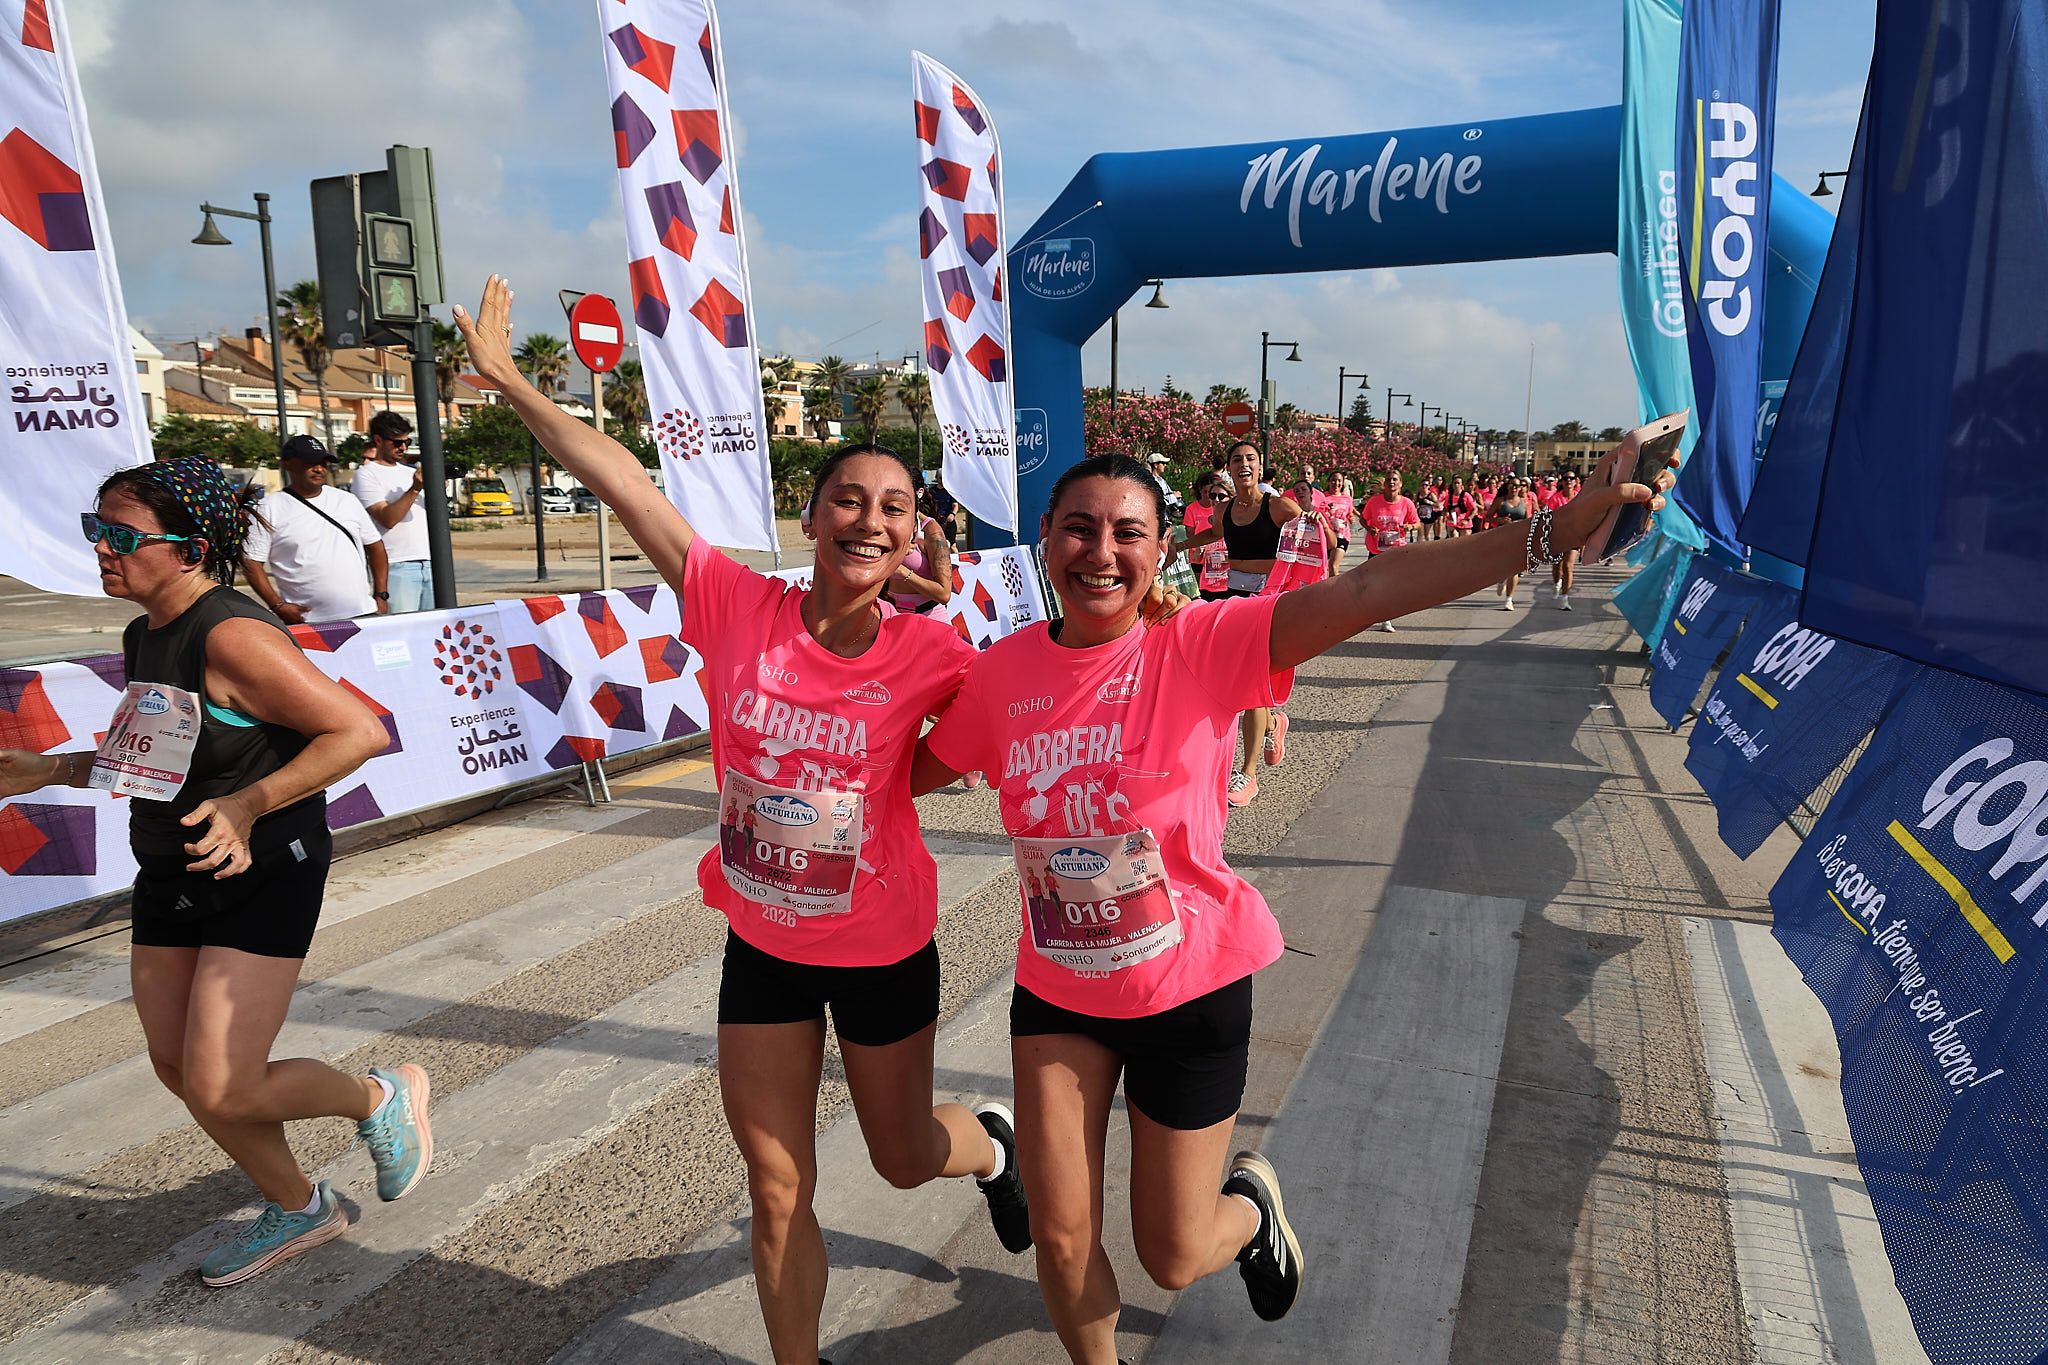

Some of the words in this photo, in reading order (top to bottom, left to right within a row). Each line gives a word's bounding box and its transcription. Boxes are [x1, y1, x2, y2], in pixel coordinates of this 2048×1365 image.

[1239, 137, 1483, 248] Marlene
[1027, 252, 1090, 283] Marlene
[1067, 281, 1086, 294] ALPES
[1018, 456, 1039, 471] ALPES
[1679, 577, 1719, 622] GOYA
[1750, 621, 1836, 691] GOYA
[450, 706, 516, 728] Experience
[1008, 696, 1054, 718] OYSHO
[732, 688, 868, 758] CARRERA
[119, 732, 153, 754] 016
[1004, 722, 1124, 779] CARRERA
[462, 744, 529, 775] OMAN
[130, 781, 167, 795] Santander
[732, 783, 754, 798] SUMA
[759, 802, 814, 823] ASTURIANA
[1063, 782, 1105, 838] DE
[755, 840, 808, 870] 016
[1022, 851, 1046, 860] SUMA
[1054, 858, 1106, 872] ASTURIANA
[767, 867, 792, 882] 2672
[1825, 858, 1846, 878] es
[733, 875, 767, 897] OYSHO
[754, 874, 763, 882] DE
[764, 877, 773, 885] LA
[774, 880, 797, 893] MUJER
[803, 886, 837, 895] VALENCIA
[1121, 881, 1162, 902] CORREDORA
[761, 904, 797, 928] 2026
[791, 900, 836, 911] Santander
[1065, 899, 1121, 924] 016
[1046, 938, 1075, 948] CARRERA
[1075, 940, 1085, 948] DE
[1085, 940, 1095, 948] LA
[1096, 936, 1122, 947] MUJER
[1127, 920, 1163, 940] VALENCIA
[1084, 927, 1112, 938] 2346
[1122, 935, 1167, 960] Santander
[1873, 920, 1917, 973] tiene
[1051, 953, 1094, 965] OYSHO
[1884, 962, 1926, 1003] que
[1929, 1008, 2004, 1095] bueno!
